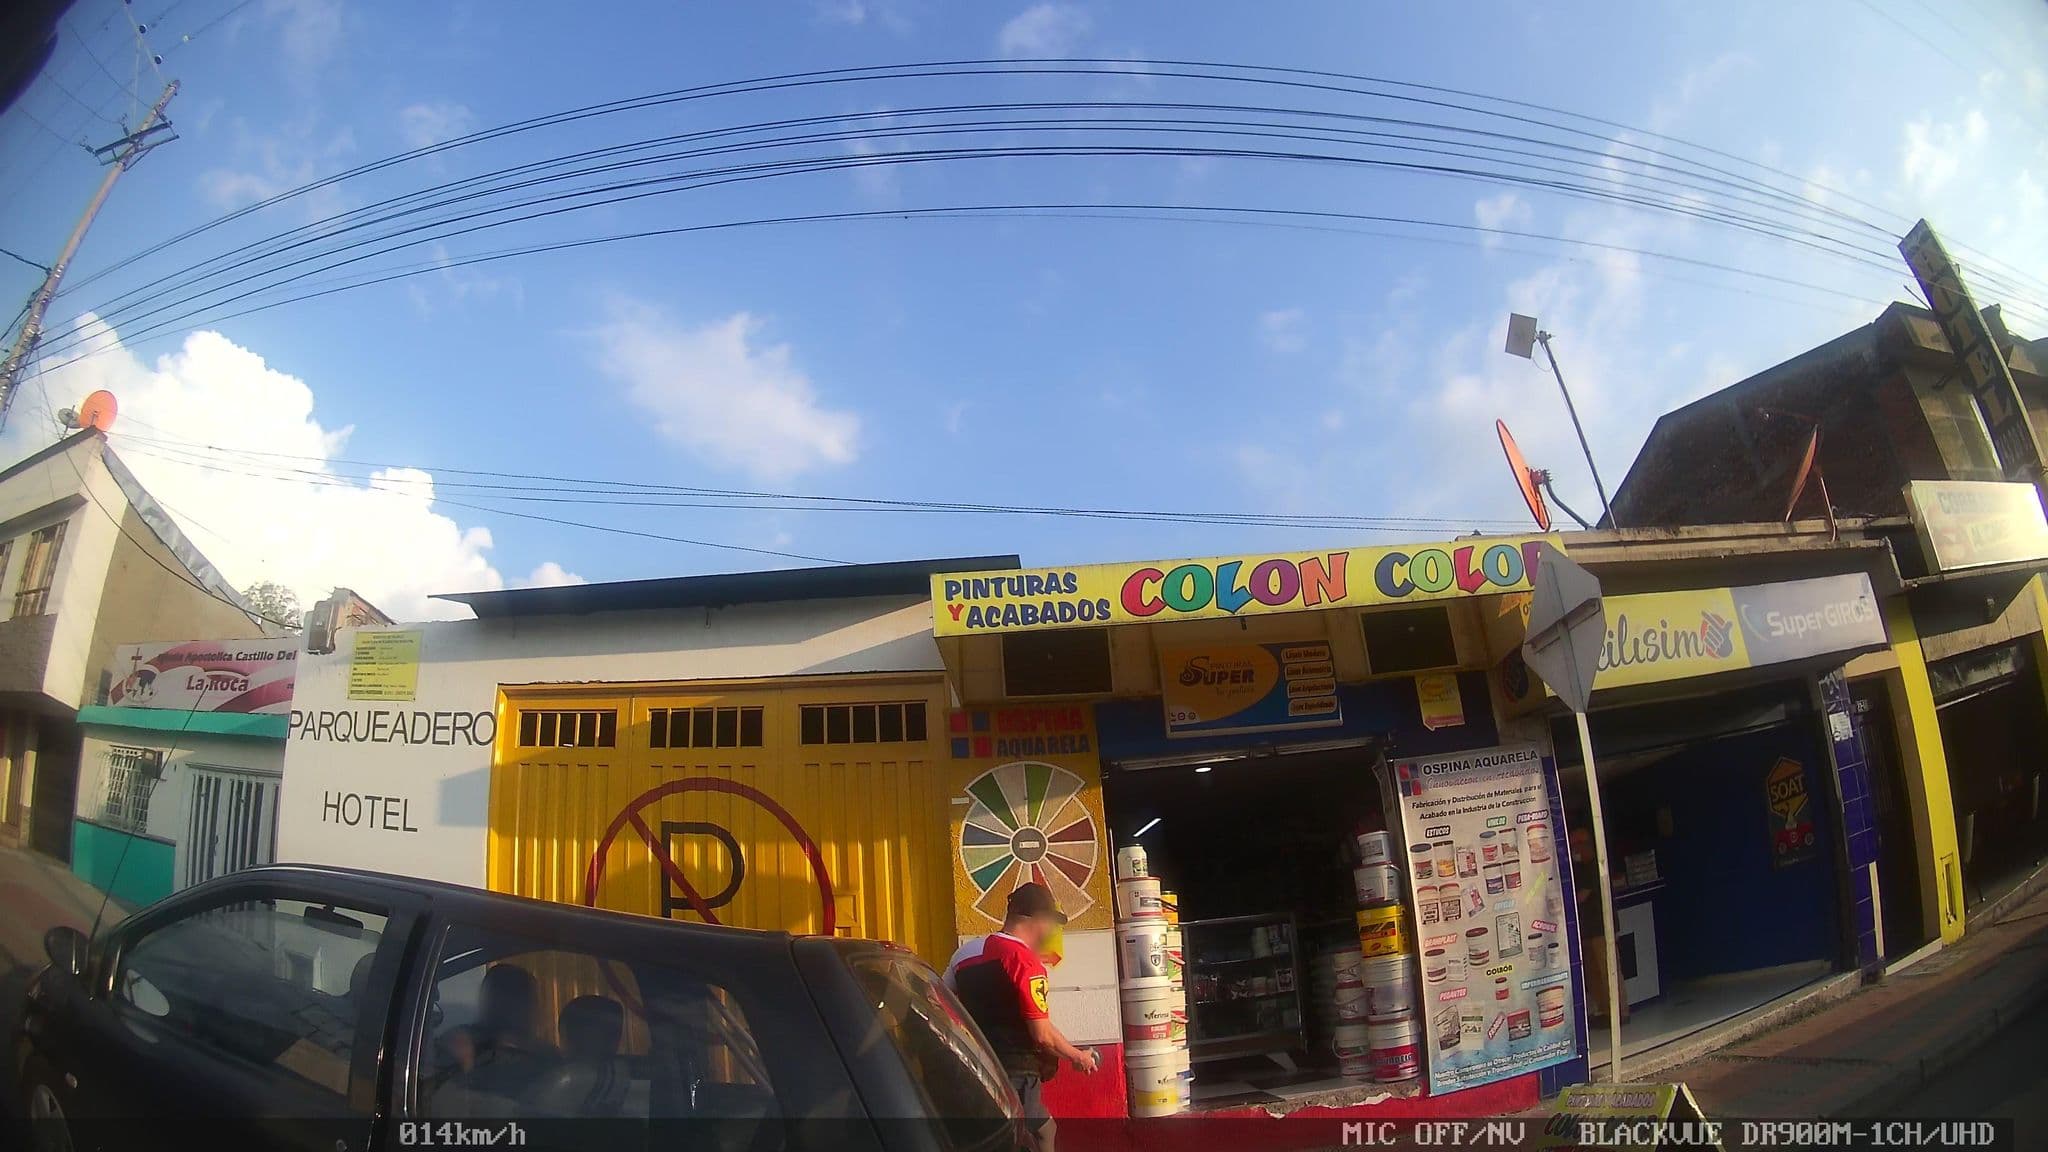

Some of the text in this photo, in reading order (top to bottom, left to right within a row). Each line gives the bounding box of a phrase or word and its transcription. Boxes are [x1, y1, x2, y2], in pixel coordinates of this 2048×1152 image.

[945, 572, 1077, 600] PINTURAS
[1120, 552, 1349, 616] COLON
[947, 599, 1111, 628] Y ACABADOS
[235, 651, 273, 662] Castillo
[277, 651, 296, 661] Del
[187, 674, 249, 691] La Roca
[288, 710, 497, 746] PARQUEADERO
[998, 734, 1091, 757] AQUARELA
[1423, 751, 1538, 776] OSPINA AQUARELA
[1770, 774, 1804, 802] SOAT
[323, 791, 418, 832] HOTEL
